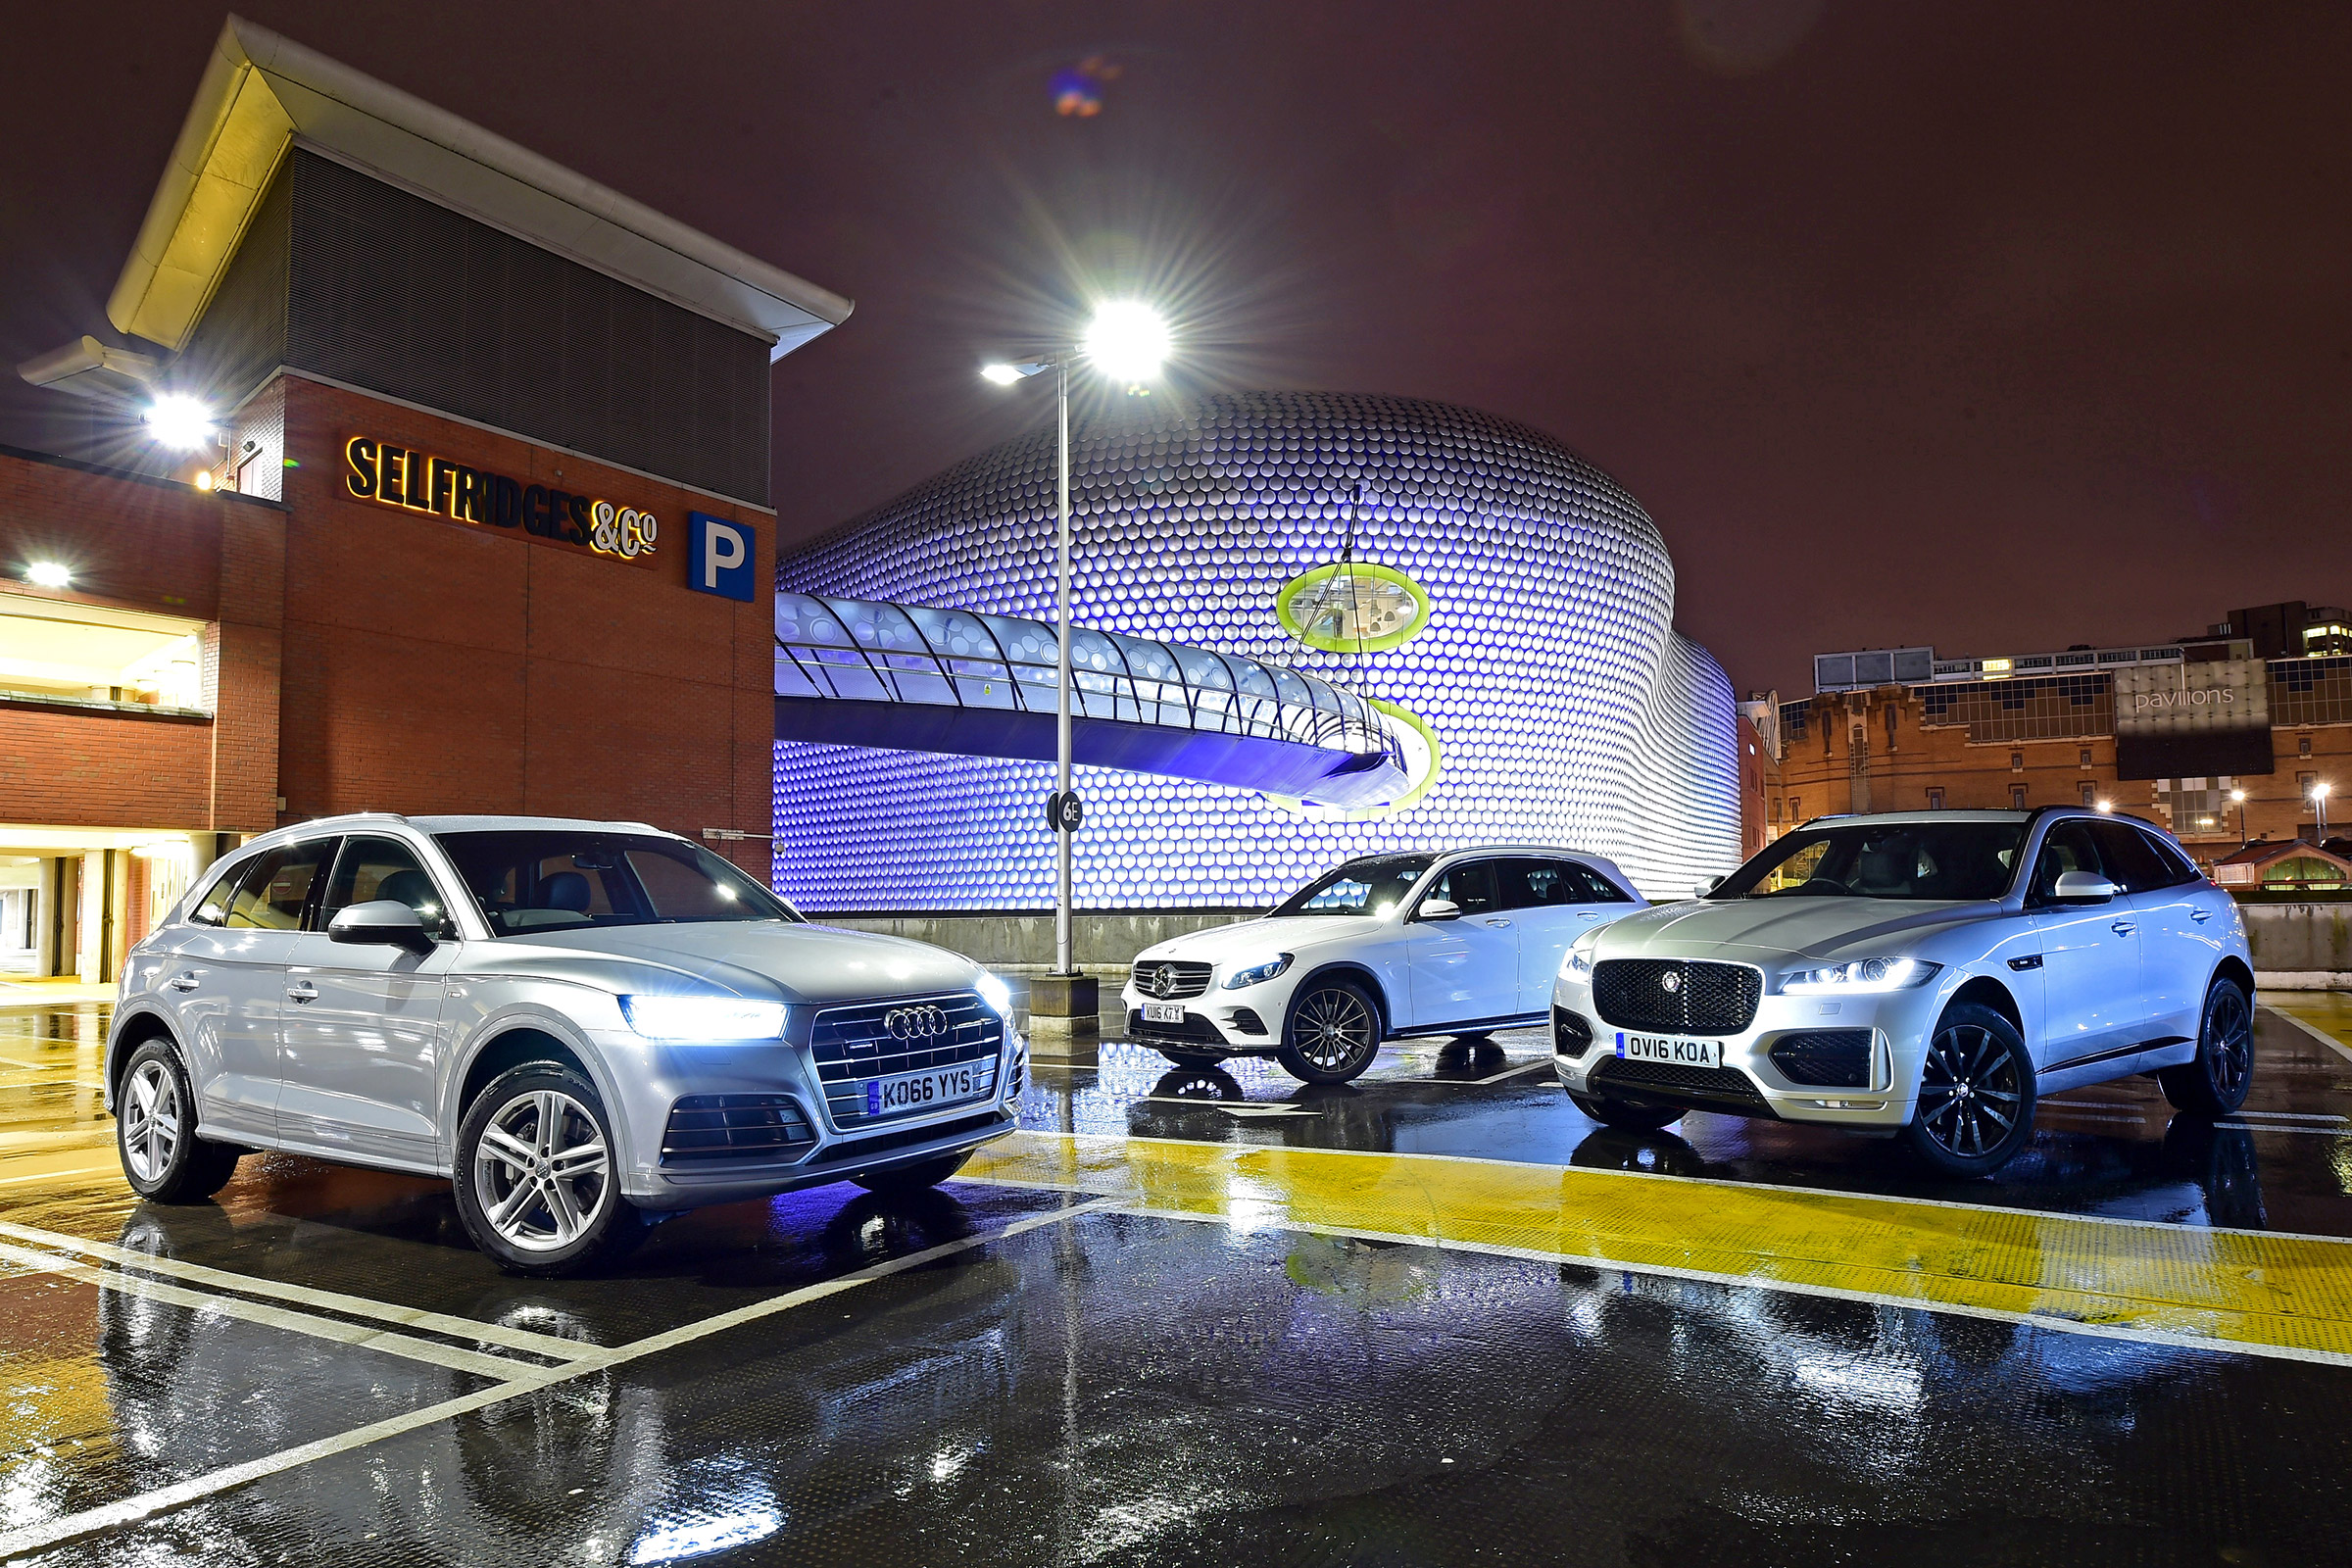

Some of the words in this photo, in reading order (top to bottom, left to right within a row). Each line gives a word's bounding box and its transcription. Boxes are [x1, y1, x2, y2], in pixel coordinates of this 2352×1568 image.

[705, 520, 746, 588] P
[2135, 663, 2234, 713] pavilions
[1062, 801, 1078, 821] 6E
[1630, 1037, 1669, 1059] OV16
[1674, 1041, 1710, 1063] KOA
[939, 1069, 970, 1097] YYS
